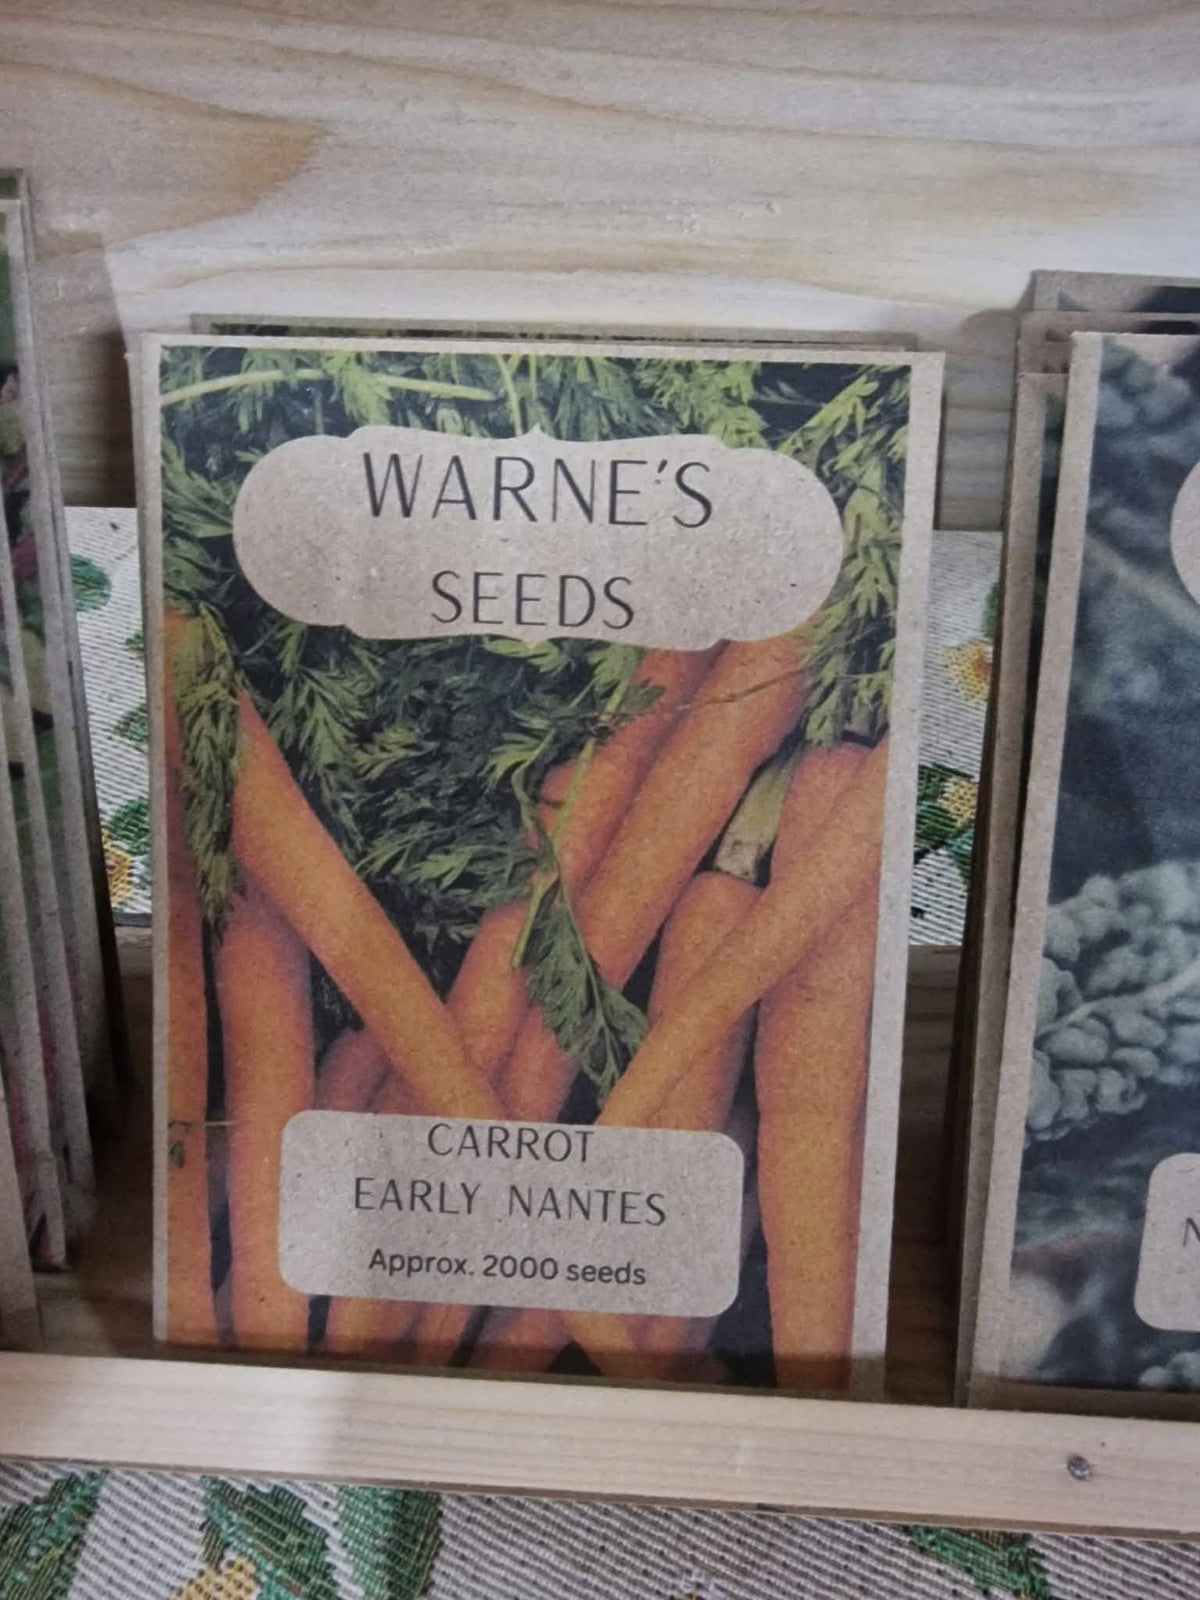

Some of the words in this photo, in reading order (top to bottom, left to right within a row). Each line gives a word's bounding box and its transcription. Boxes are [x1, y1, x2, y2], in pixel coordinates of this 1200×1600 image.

[362, 452, 713, 528] WARNE'S
[431, 570, 636, 630] SEEDS
[427, 1122, 595, 1163] CARROT
[354, 1176, 481, 1215] EARLY
[508, 1184, 667, 1227] NANTES
[368, 1248, 475, 1277] Approx.
[482, 1254, 559, 1280] 2000
[566, 1261, 647, 1286] seeds
